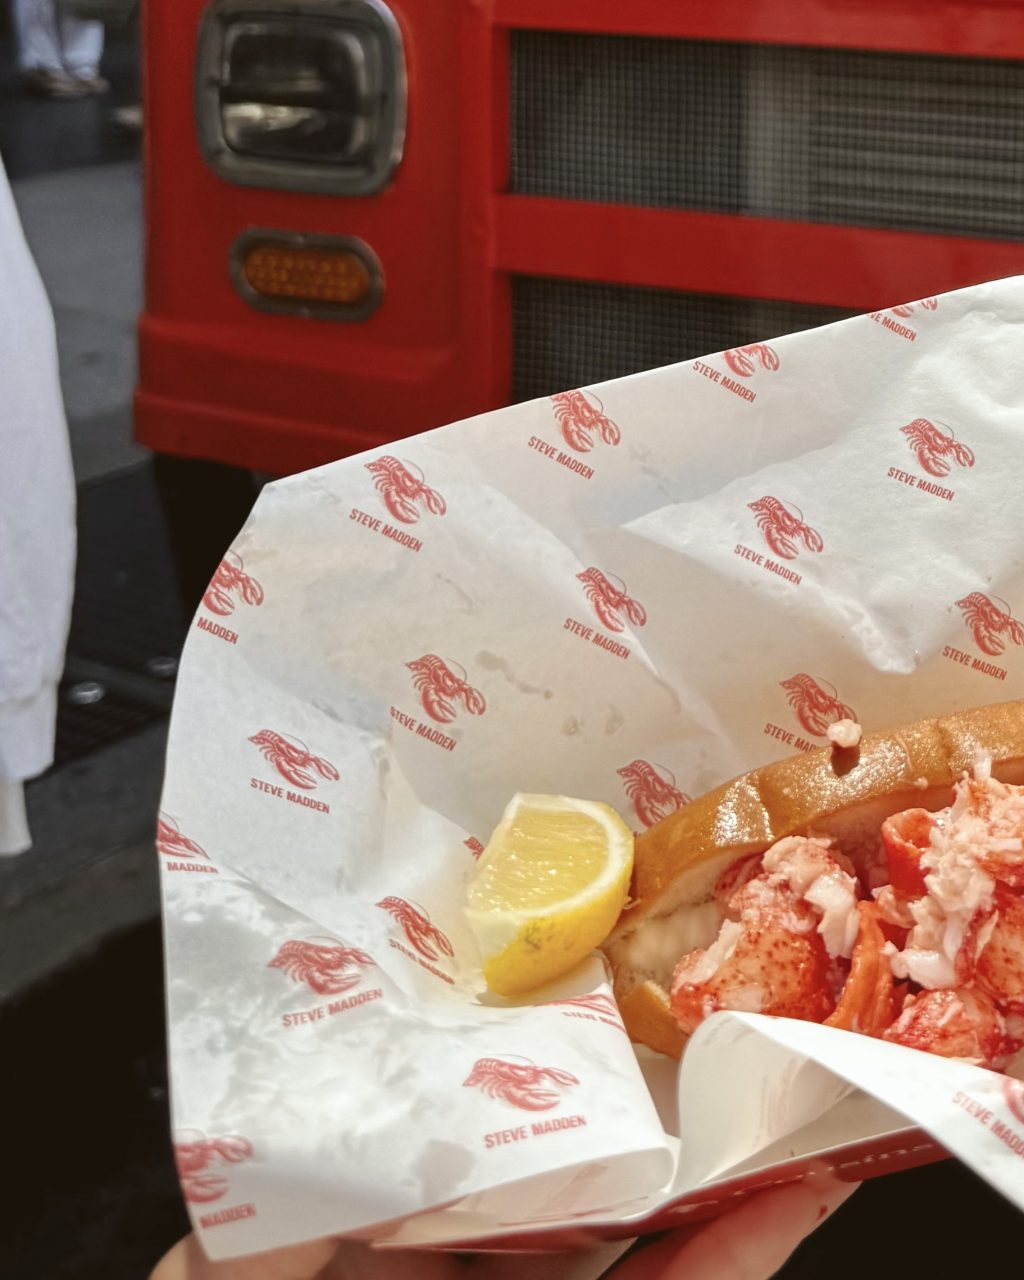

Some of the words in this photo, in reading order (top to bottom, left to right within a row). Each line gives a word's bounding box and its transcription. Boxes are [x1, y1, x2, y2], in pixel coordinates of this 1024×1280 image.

[881, 316, 917, 341] MADDEN
[692, 360, 721, 382] STEVE
[720, 374, 757, 402] MADDEN
[527, 435, 556, 460] STEVE
[555, 451, 595, 480] MADDEN
[887, 466, 917, 488] STEVE
[916, 478, 955, 502] MADDEN
[349, 508, 381, 532] STEVE
[381, 522, 424, 552] MADDEN
[733, 544, 763, 567] STEVE
[763, 557, 802, 586] MADDEN
[197, 616, 239, 645] MADDEN
[563, 617, 593, 641] STEVE
[592, 633, 631, 660] MADDEN
[942, 645, 971, 666] STEVE
[971, 658, 1008, 681] MADDEN
[390, 706, 416, 732] STEVE
[416, 723, 457, 752] MADDEN
[763, 722, 795, 745] STEVE
[794, 736, 817, 752] MAD
[250, 777, 284, 798] STEVE
[286, 791, 330, 815] MADDEN
[167, 861, 219, 874] MADDEN
[282, 1007, 325, 1028] STEVE
[327, 988, 383, 1015] MADDEN
[952, 1090, 994, 1125] STEVE
[484, 1125, 529, 1150] STEVE
[529, 1114, 588, 1138] MADDEN
[200, 1201, 257, 1229] MADDEN
